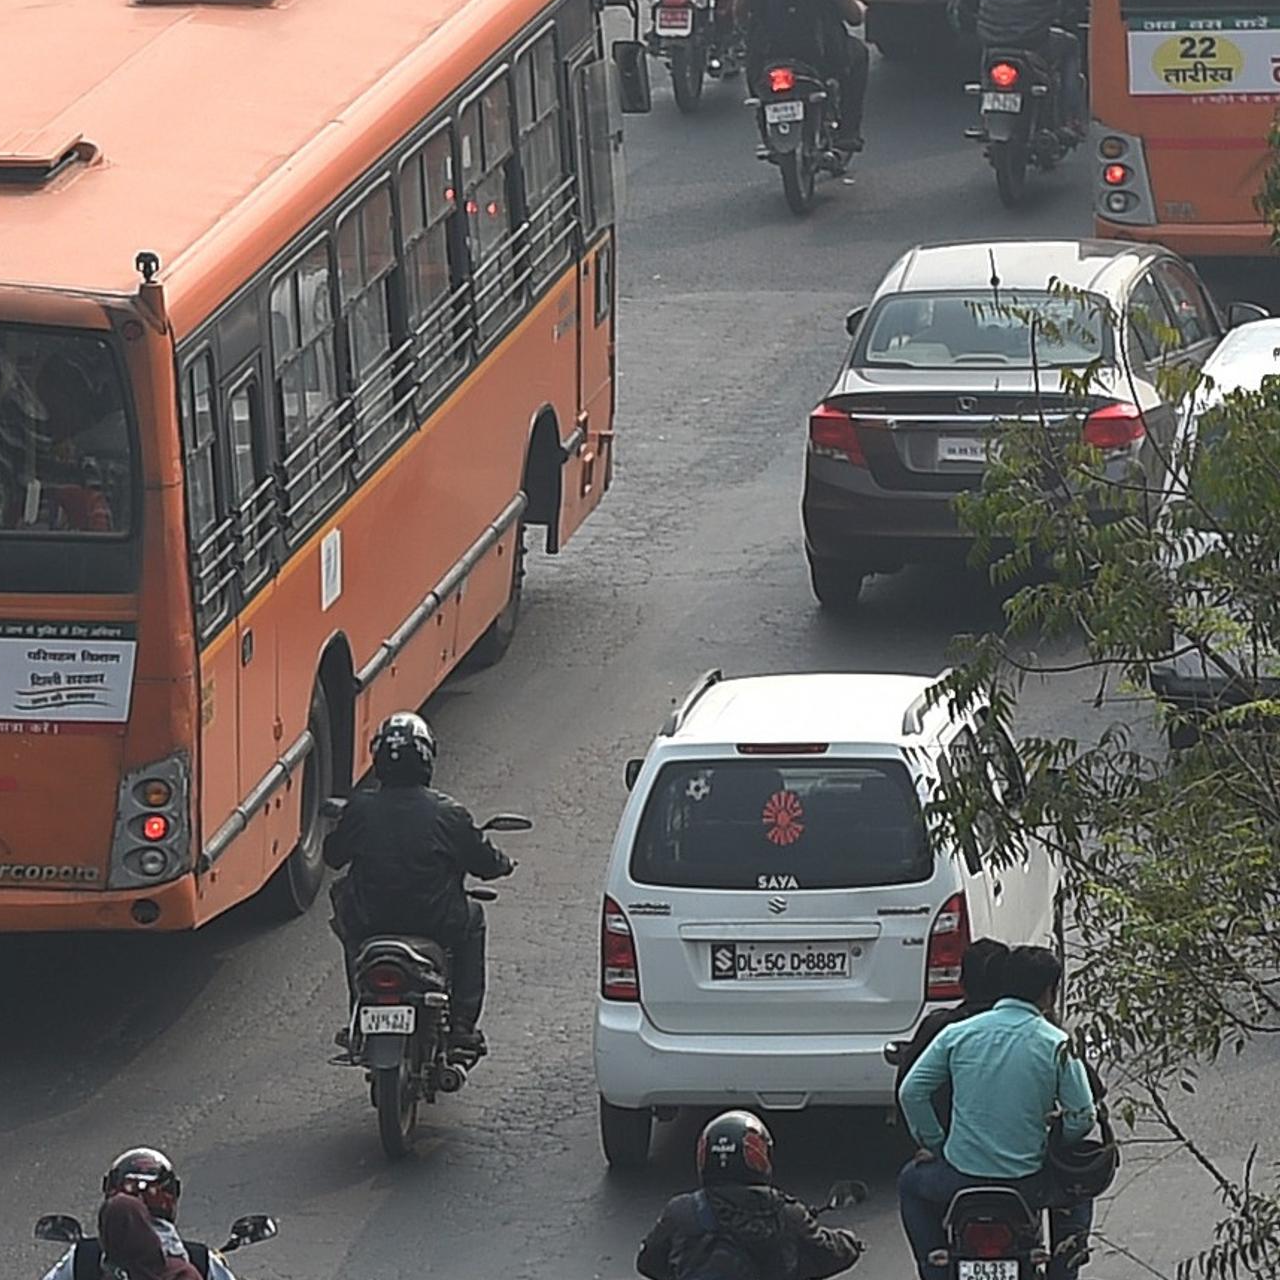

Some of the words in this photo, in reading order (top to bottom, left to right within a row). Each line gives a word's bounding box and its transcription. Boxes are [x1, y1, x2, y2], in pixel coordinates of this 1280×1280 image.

[1180, 37, 1217, 58] 22
[1163, 61, 1234, 83] तारीख
[757, 875, 800, 890] SAYA
